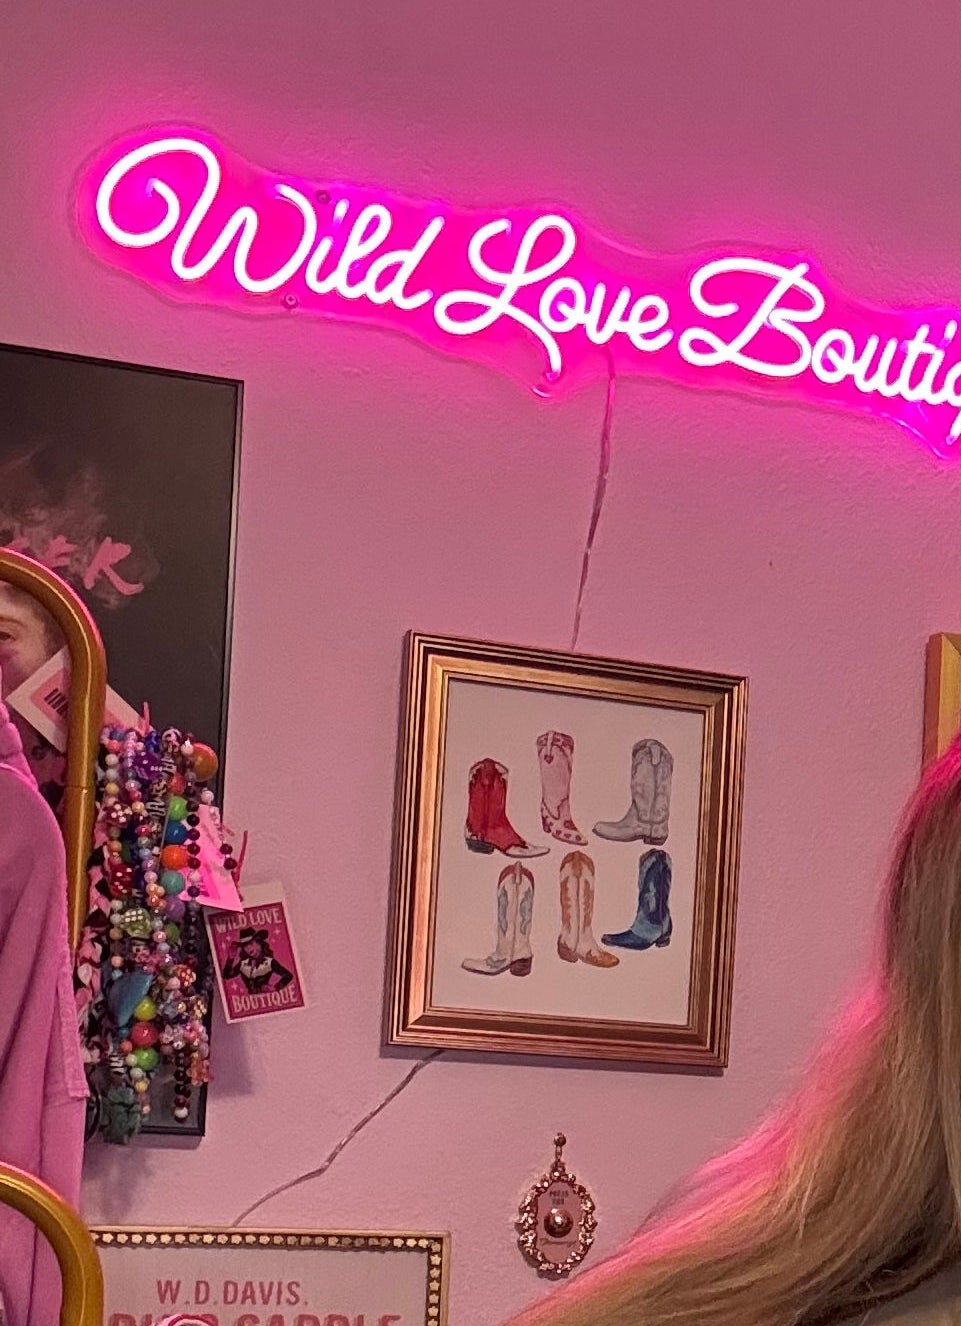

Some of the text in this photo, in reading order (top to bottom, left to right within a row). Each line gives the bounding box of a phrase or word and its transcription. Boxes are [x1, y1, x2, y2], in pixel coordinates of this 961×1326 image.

[96, 137, 445, 311] Wild
[432, 213, 676, 378] Love
[216, 907, 282, 933] WILD LOVE
[232, 984, 298, 1013] BOUTIQUE
